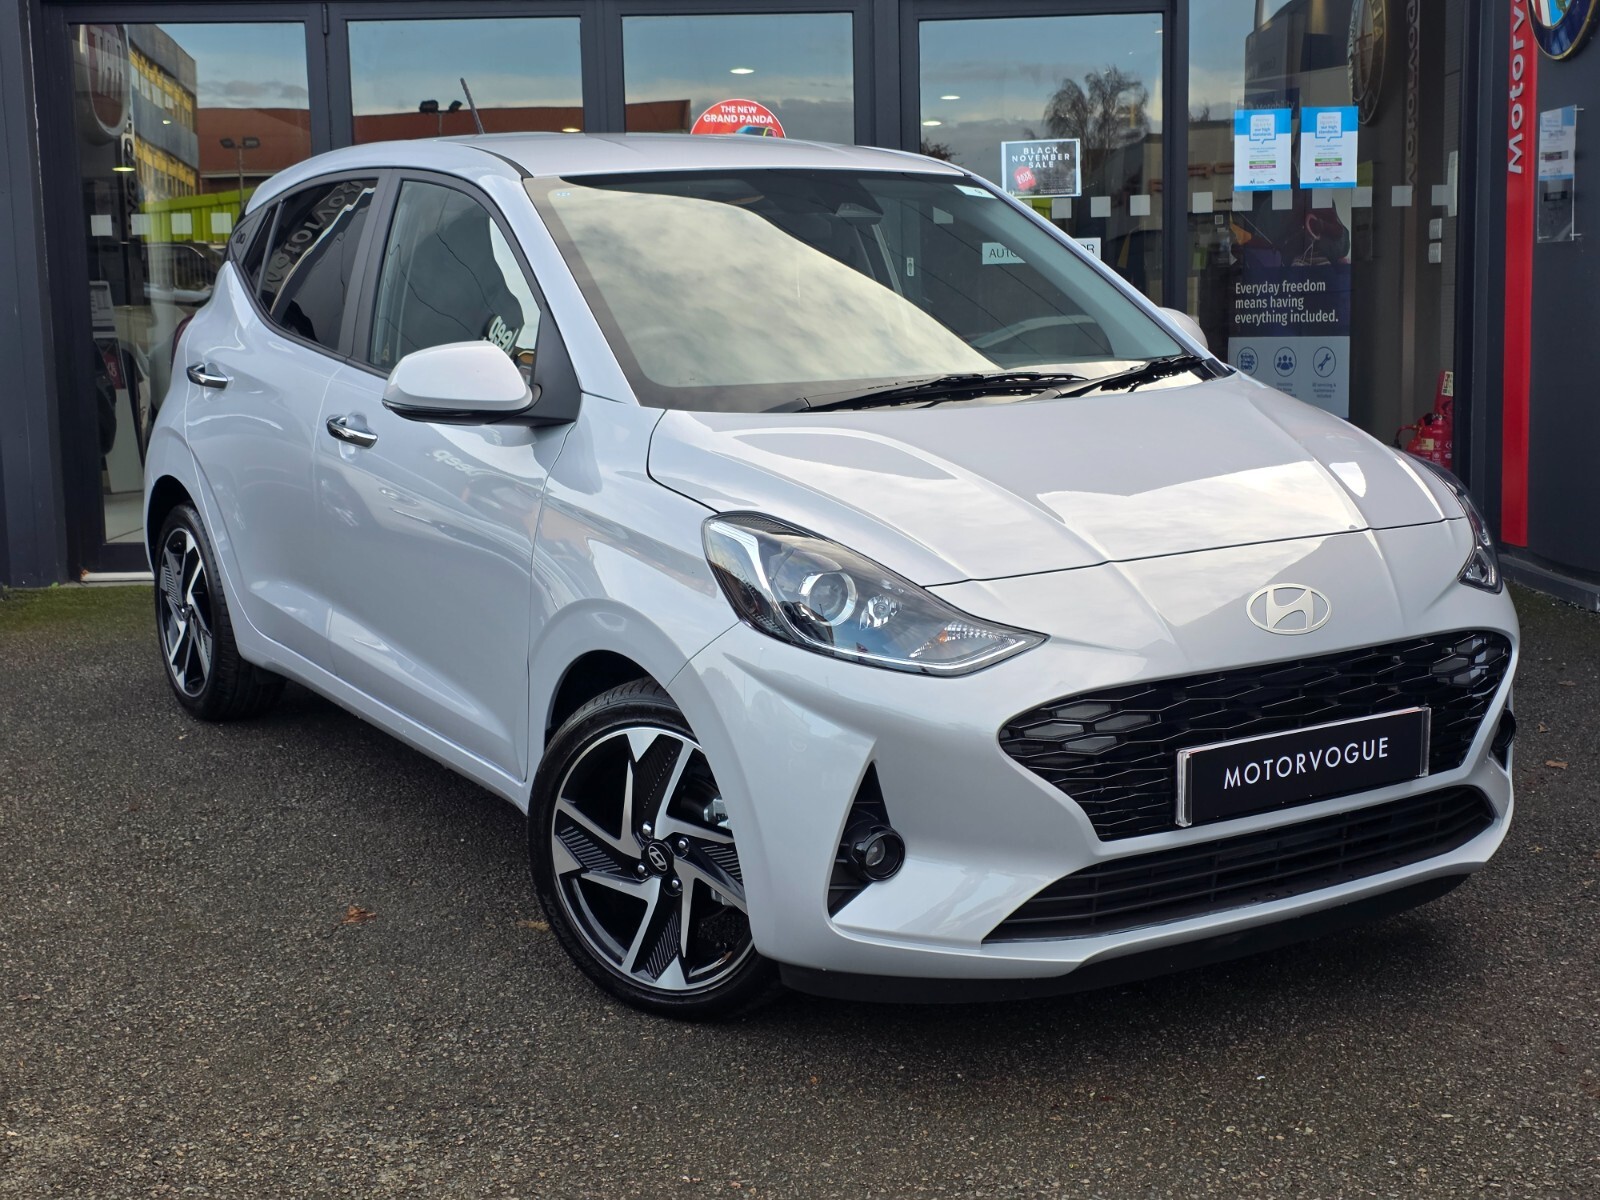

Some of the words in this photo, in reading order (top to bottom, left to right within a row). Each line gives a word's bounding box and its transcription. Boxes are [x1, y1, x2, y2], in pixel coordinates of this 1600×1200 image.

[1508, 0, 1524, 174] Motorv
[738, 106, 757, 114] NEW
[703, 114, 738, 123] GRAND
[740, 115, 773, 124] PANDA
[1023, 147, 1058, 155] BLACK
[1012, 153, 1070, 162] NOVEMBER
[1028, 161, 1054, 169] SALE
[1235, 281, 1280, 296] Everyday
[1282, 279, 1326, 292] freedom
[1235, 299, 1267, 308] means
[1270, 295, 1304, 310] having
[1235, 310, 1287, 326] everything
[1290, 309, 1339, 322] included.
[1223, 737, 1389, 790] MOTORVOGUE
